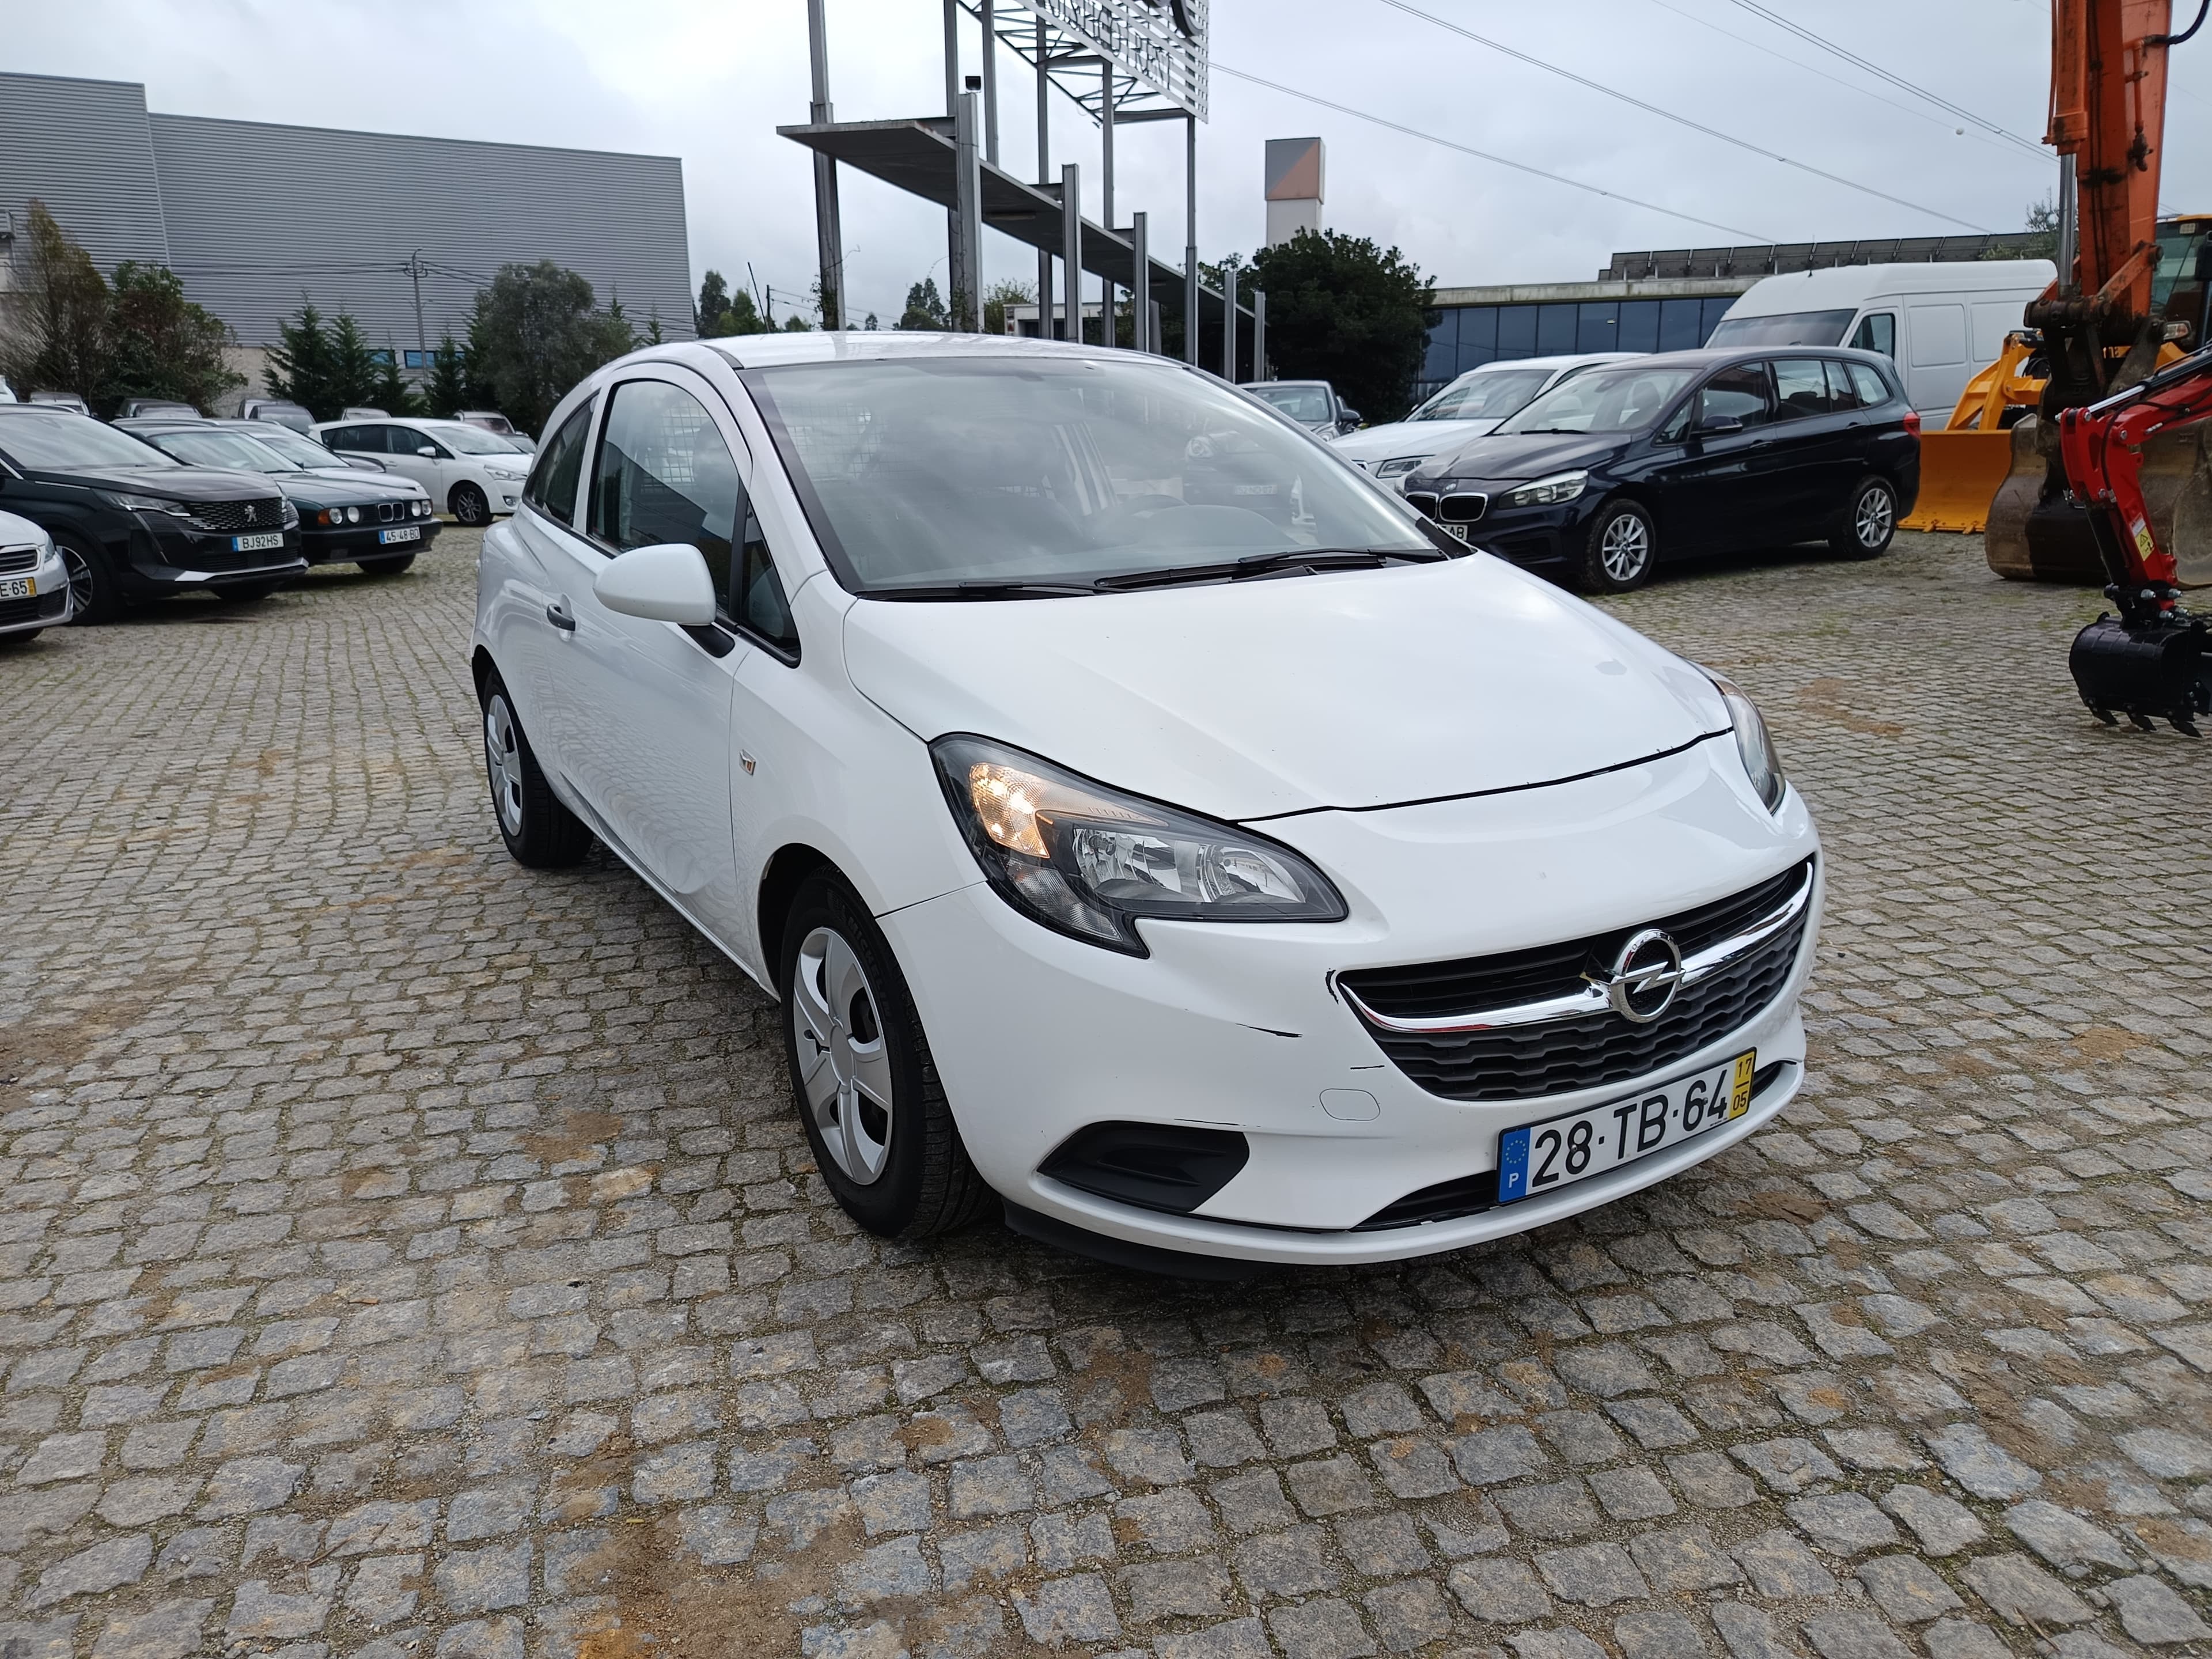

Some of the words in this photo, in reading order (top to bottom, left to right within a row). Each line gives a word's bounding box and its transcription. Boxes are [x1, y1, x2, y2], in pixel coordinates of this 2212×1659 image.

[1441, 525, 1464, 539] AB
[243, 535, 279, 549] BJ92HS
[848, 916, 891, 1018] MICHELIN
[1737, 1057, 1752, 1078] 17
[1732, 1090, 1748, 1111] 05
[1508, 1172, 1520, 1188] P
